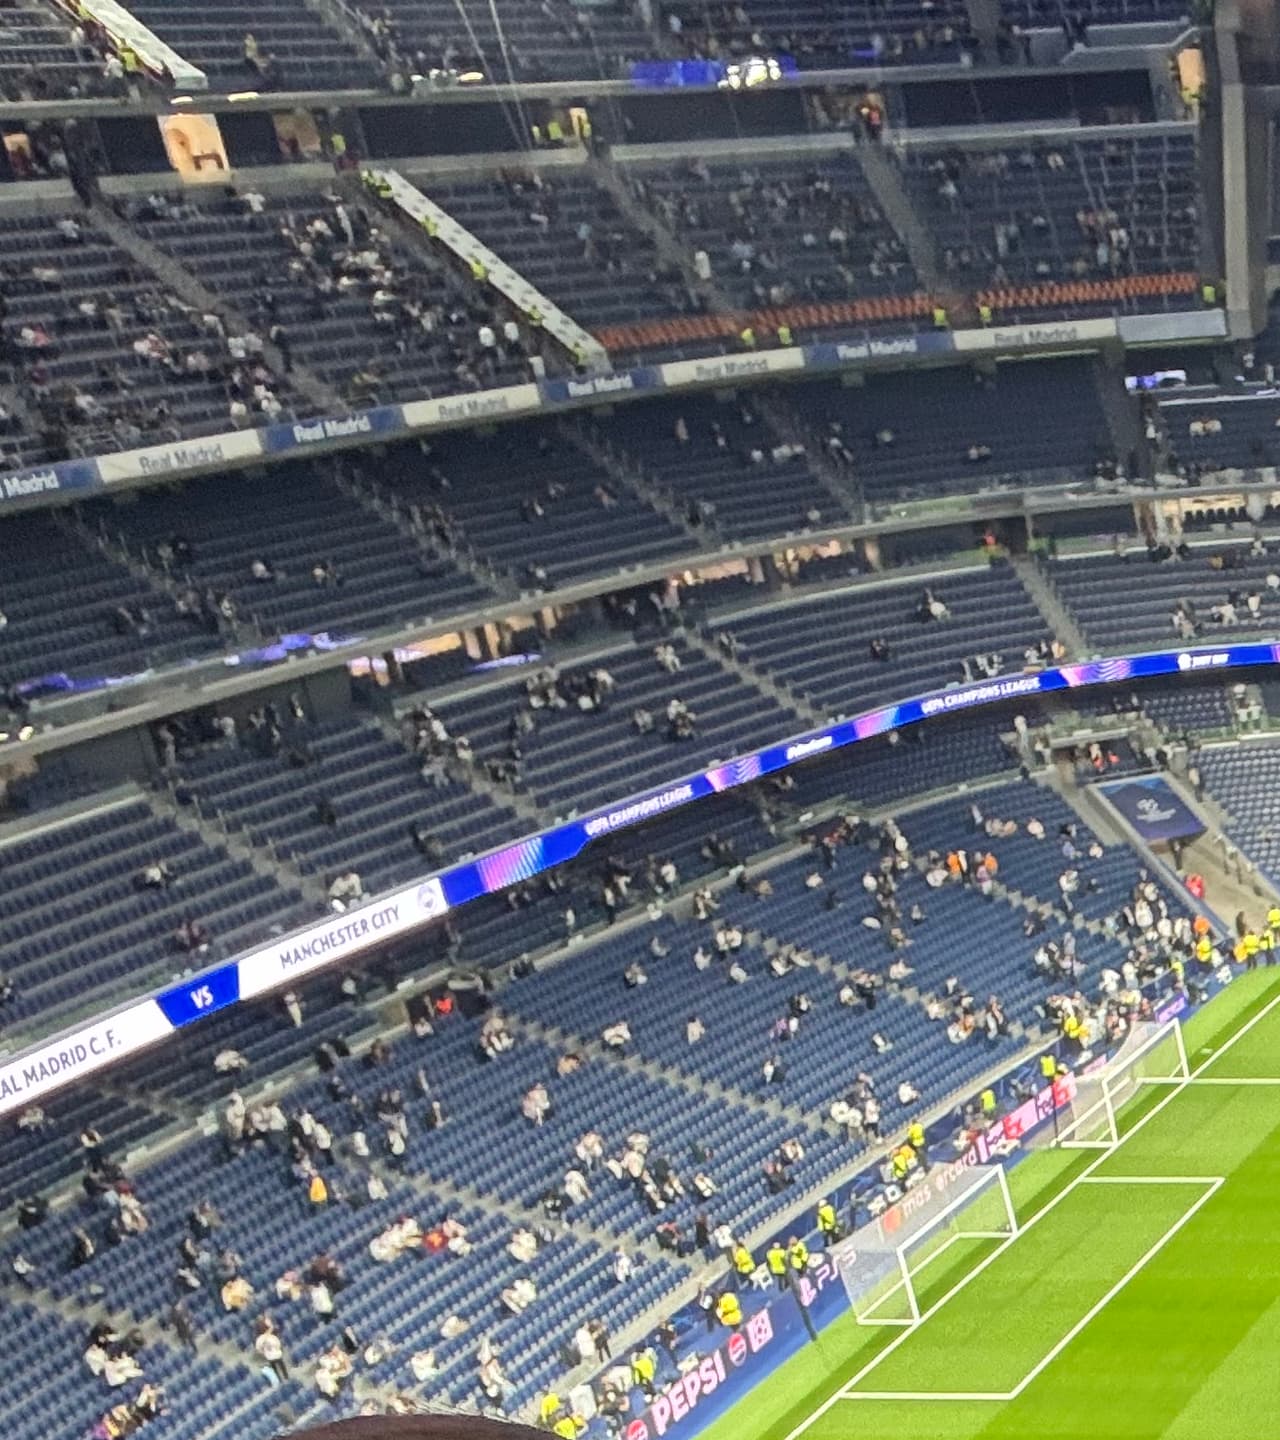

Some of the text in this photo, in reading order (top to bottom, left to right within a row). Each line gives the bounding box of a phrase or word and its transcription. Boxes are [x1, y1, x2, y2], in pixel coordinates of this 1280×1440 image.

[23, 1044, 87, 1088] MADRID
[190, 984, 214, 1009] VS
[279, 918, 370, 969] MANCHESTER
[371, 905, 400, 929] CITY
[650, 1348, 727, 1436] PEPSI
